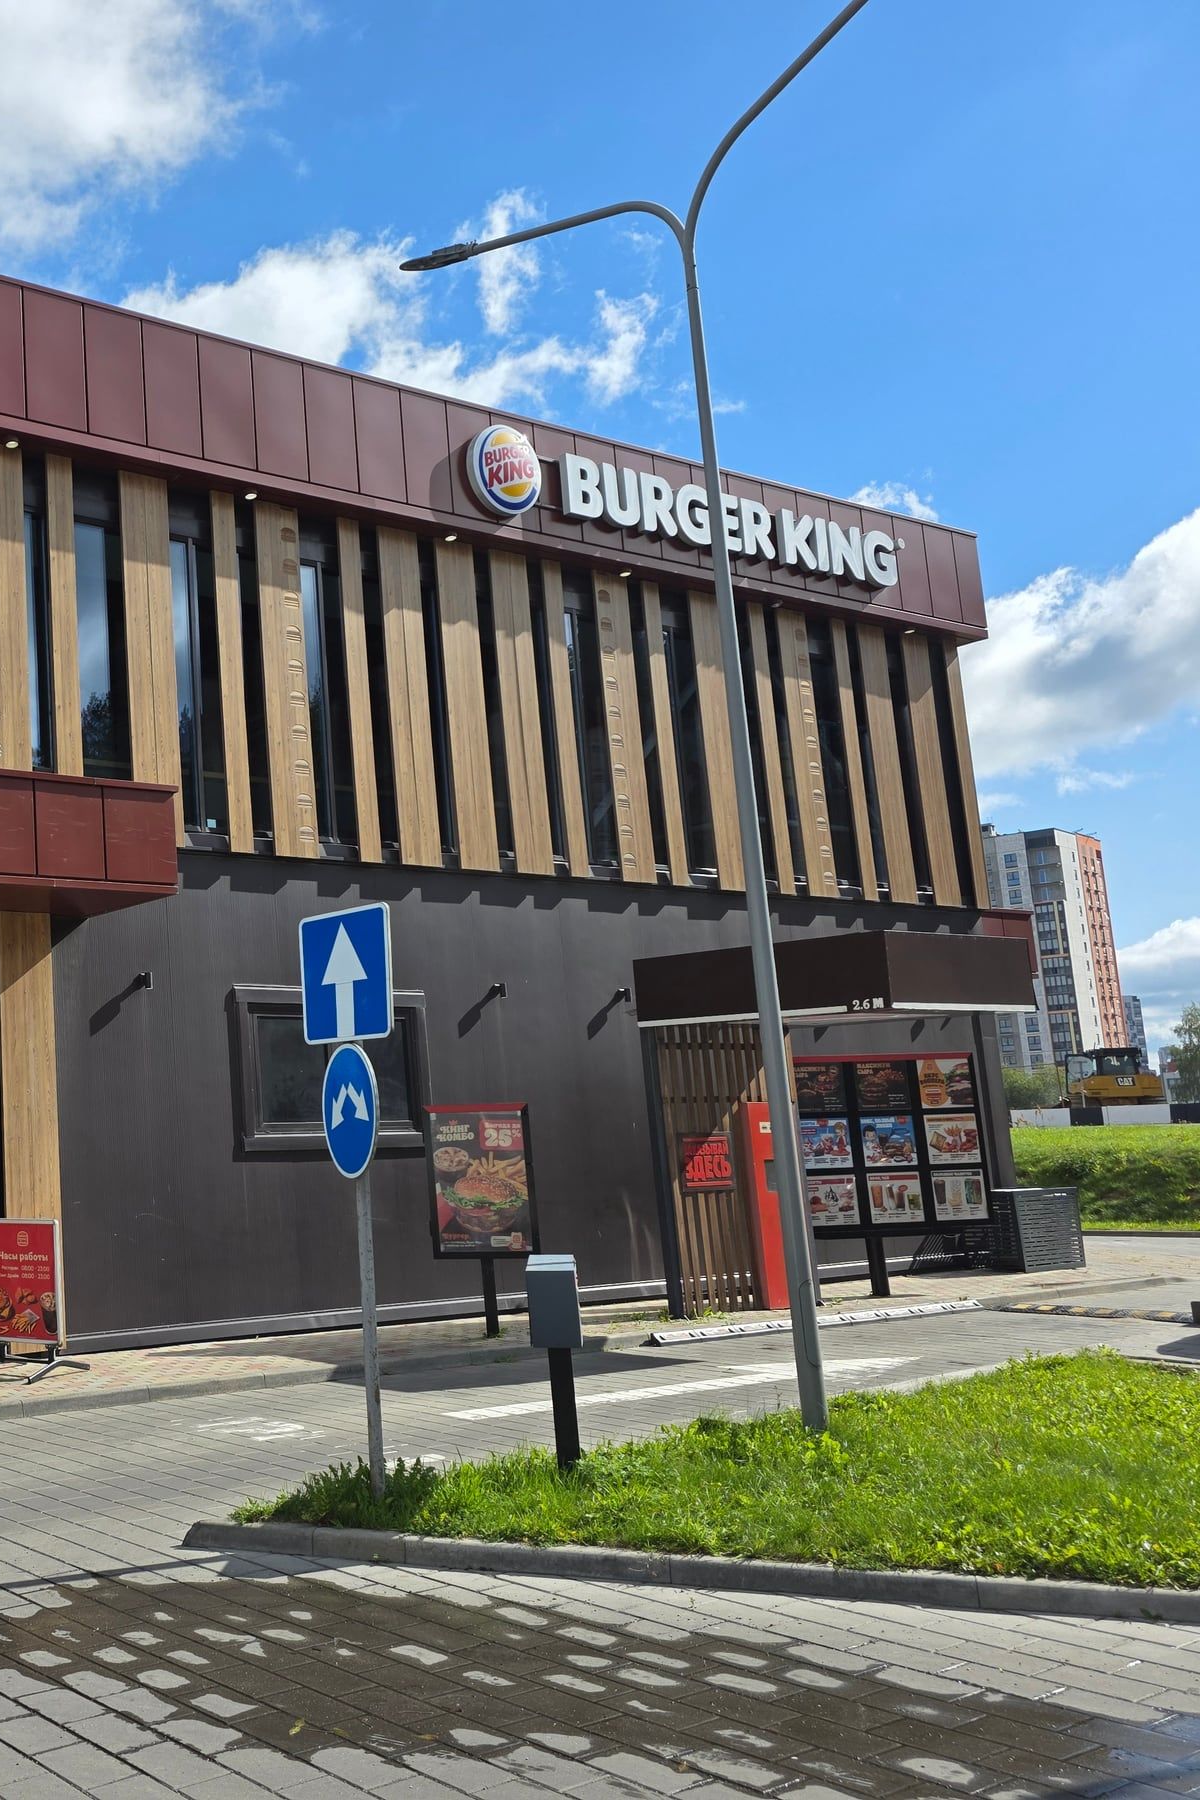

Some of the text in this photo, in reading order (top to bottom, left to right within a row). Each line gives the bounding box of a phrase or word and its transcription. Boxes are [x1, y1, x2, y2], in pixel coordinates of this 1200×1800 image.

[484, 444, 532, 467] BURGER
[487, 459, 535, 489] KING
[559, 453, 898, 588] BURGER KING
[852, 998, 871, 1011] 2.6
[1117, 1077, 1134, 1086] CAT
[439, 1124, 471, 1134] КИНГ
[436, 1132, 475, 1142] КОМБО
[685, 1155, 733, 1182] ЗДЕСЬ
[19, 1252, 48, 1262] работы
